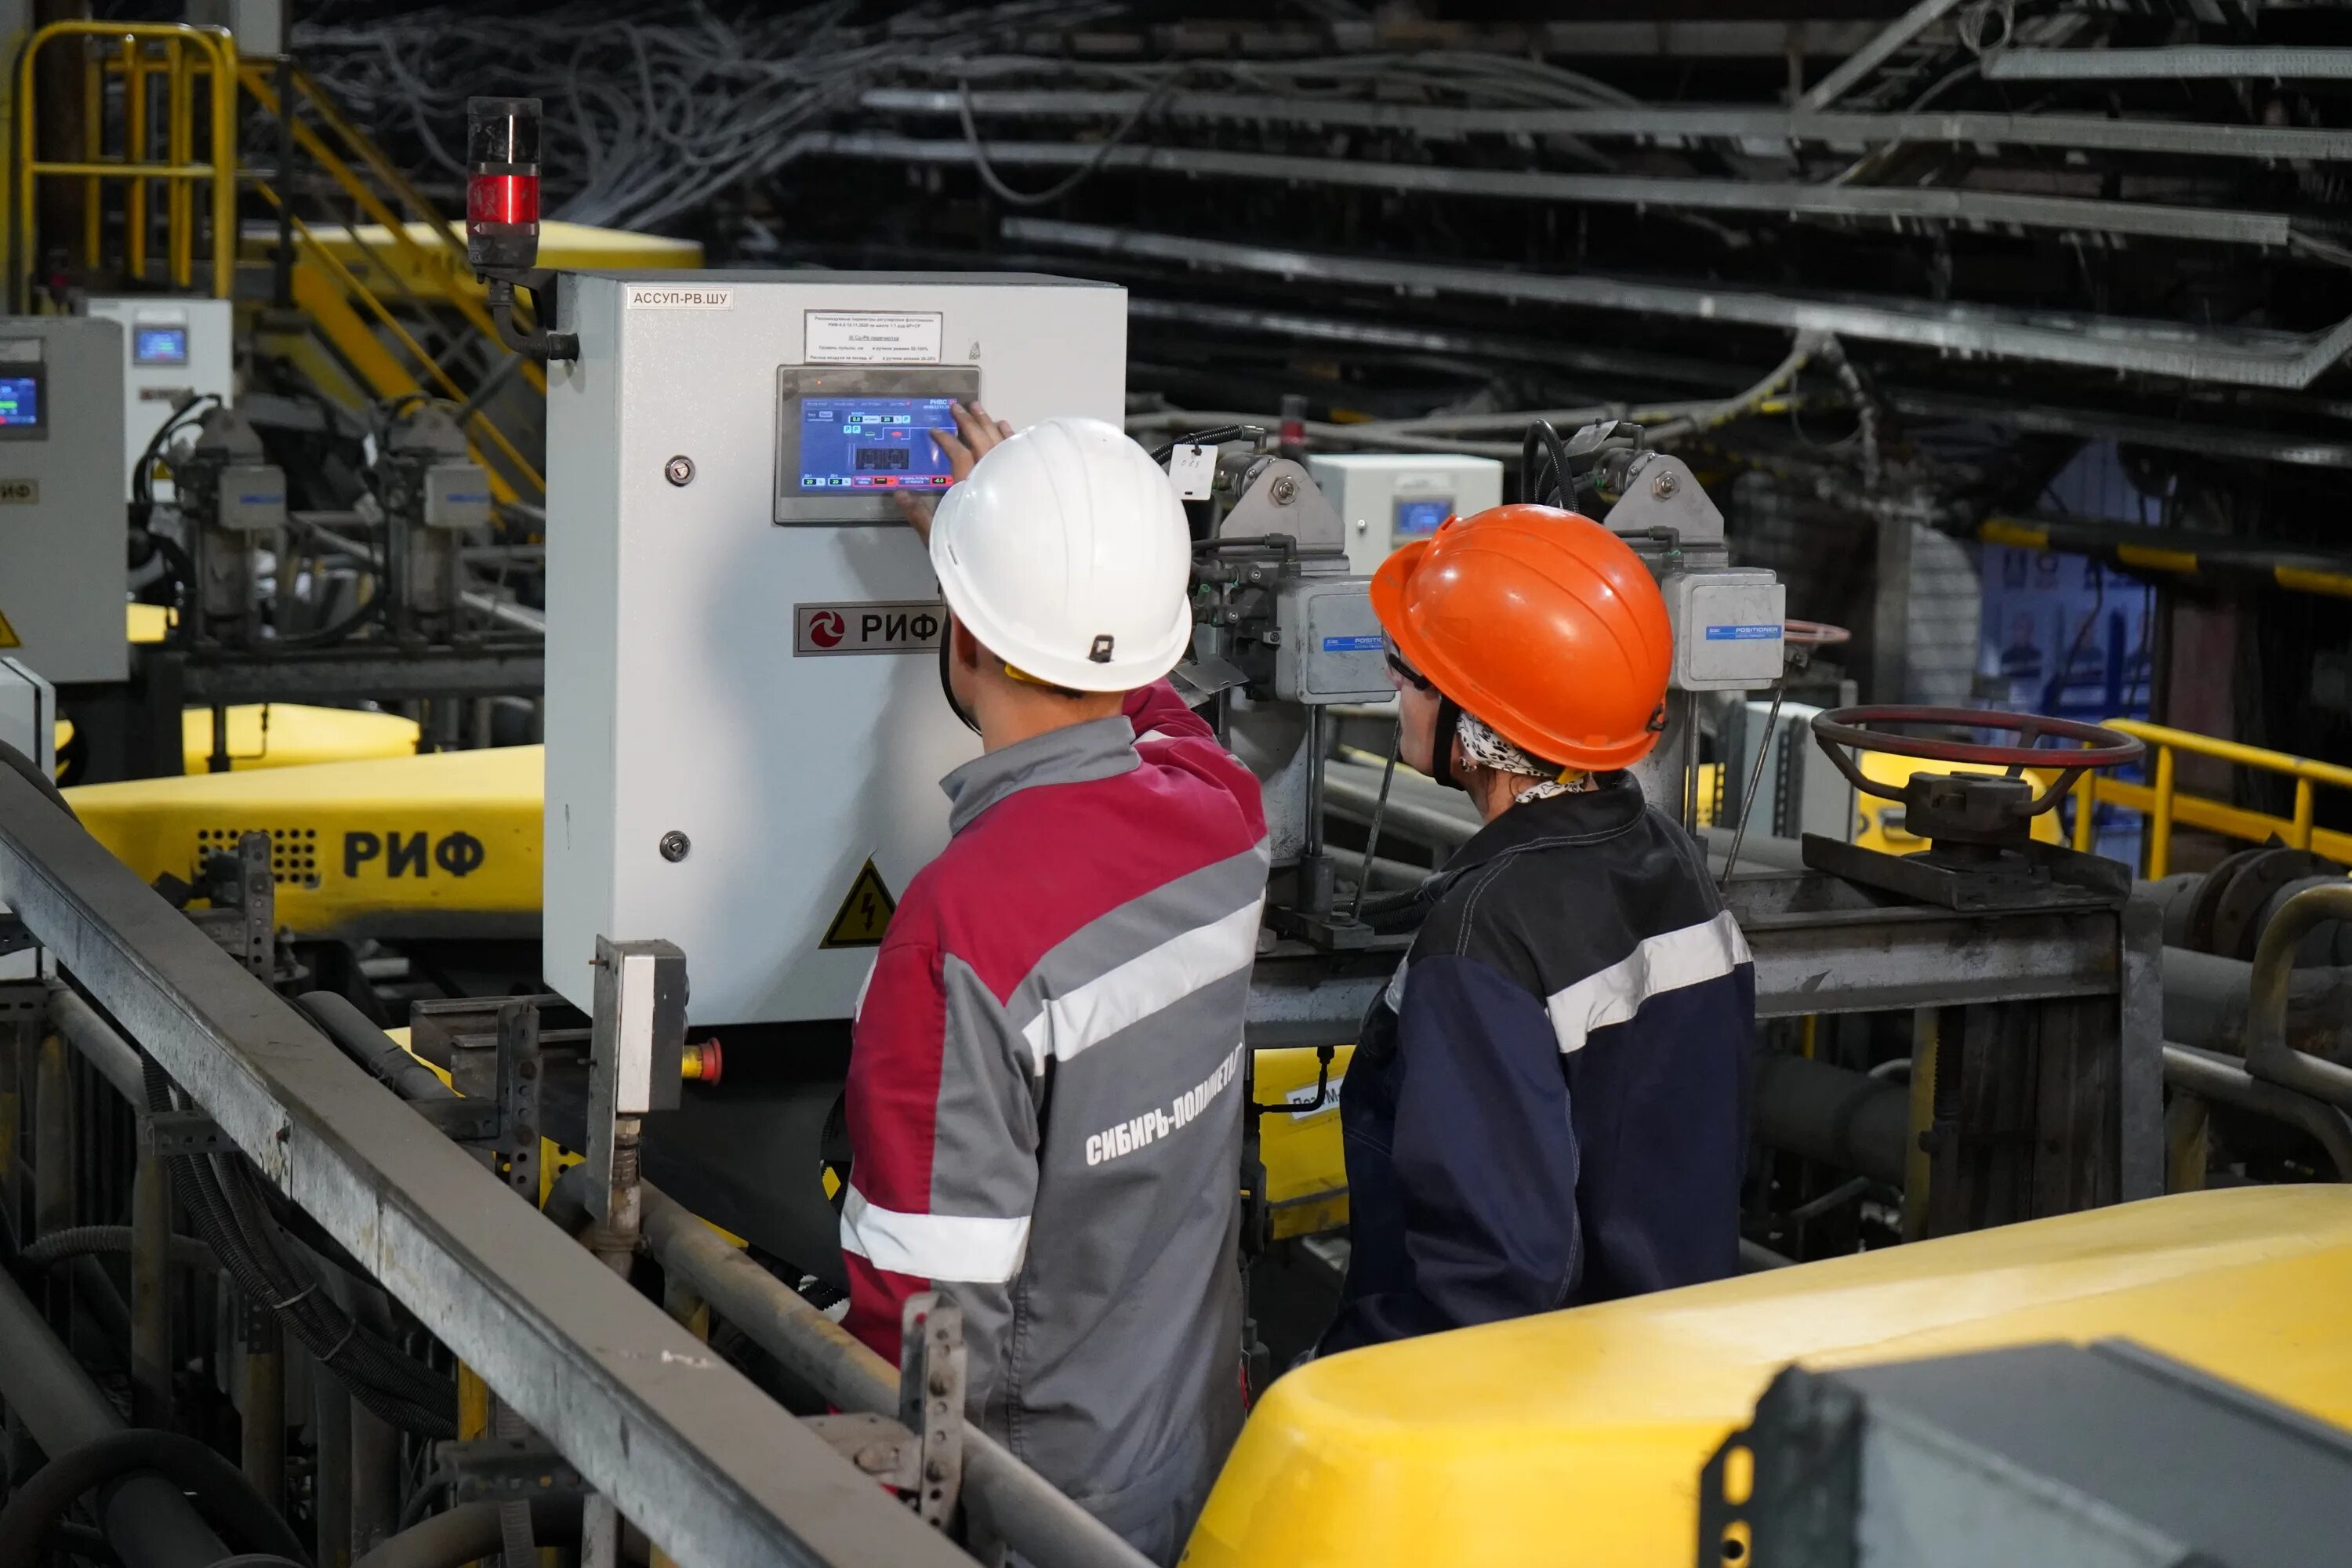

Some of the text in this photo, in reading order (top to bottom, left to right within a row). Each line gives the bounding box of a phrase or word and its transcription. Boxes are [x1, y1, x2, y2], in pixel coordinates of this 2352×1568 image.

[633, 292, 728, 304] АССУП-РВ.ШУ
[862, 614, 938, 642] РИФ
[343, 831, 485, 879] РИФ
